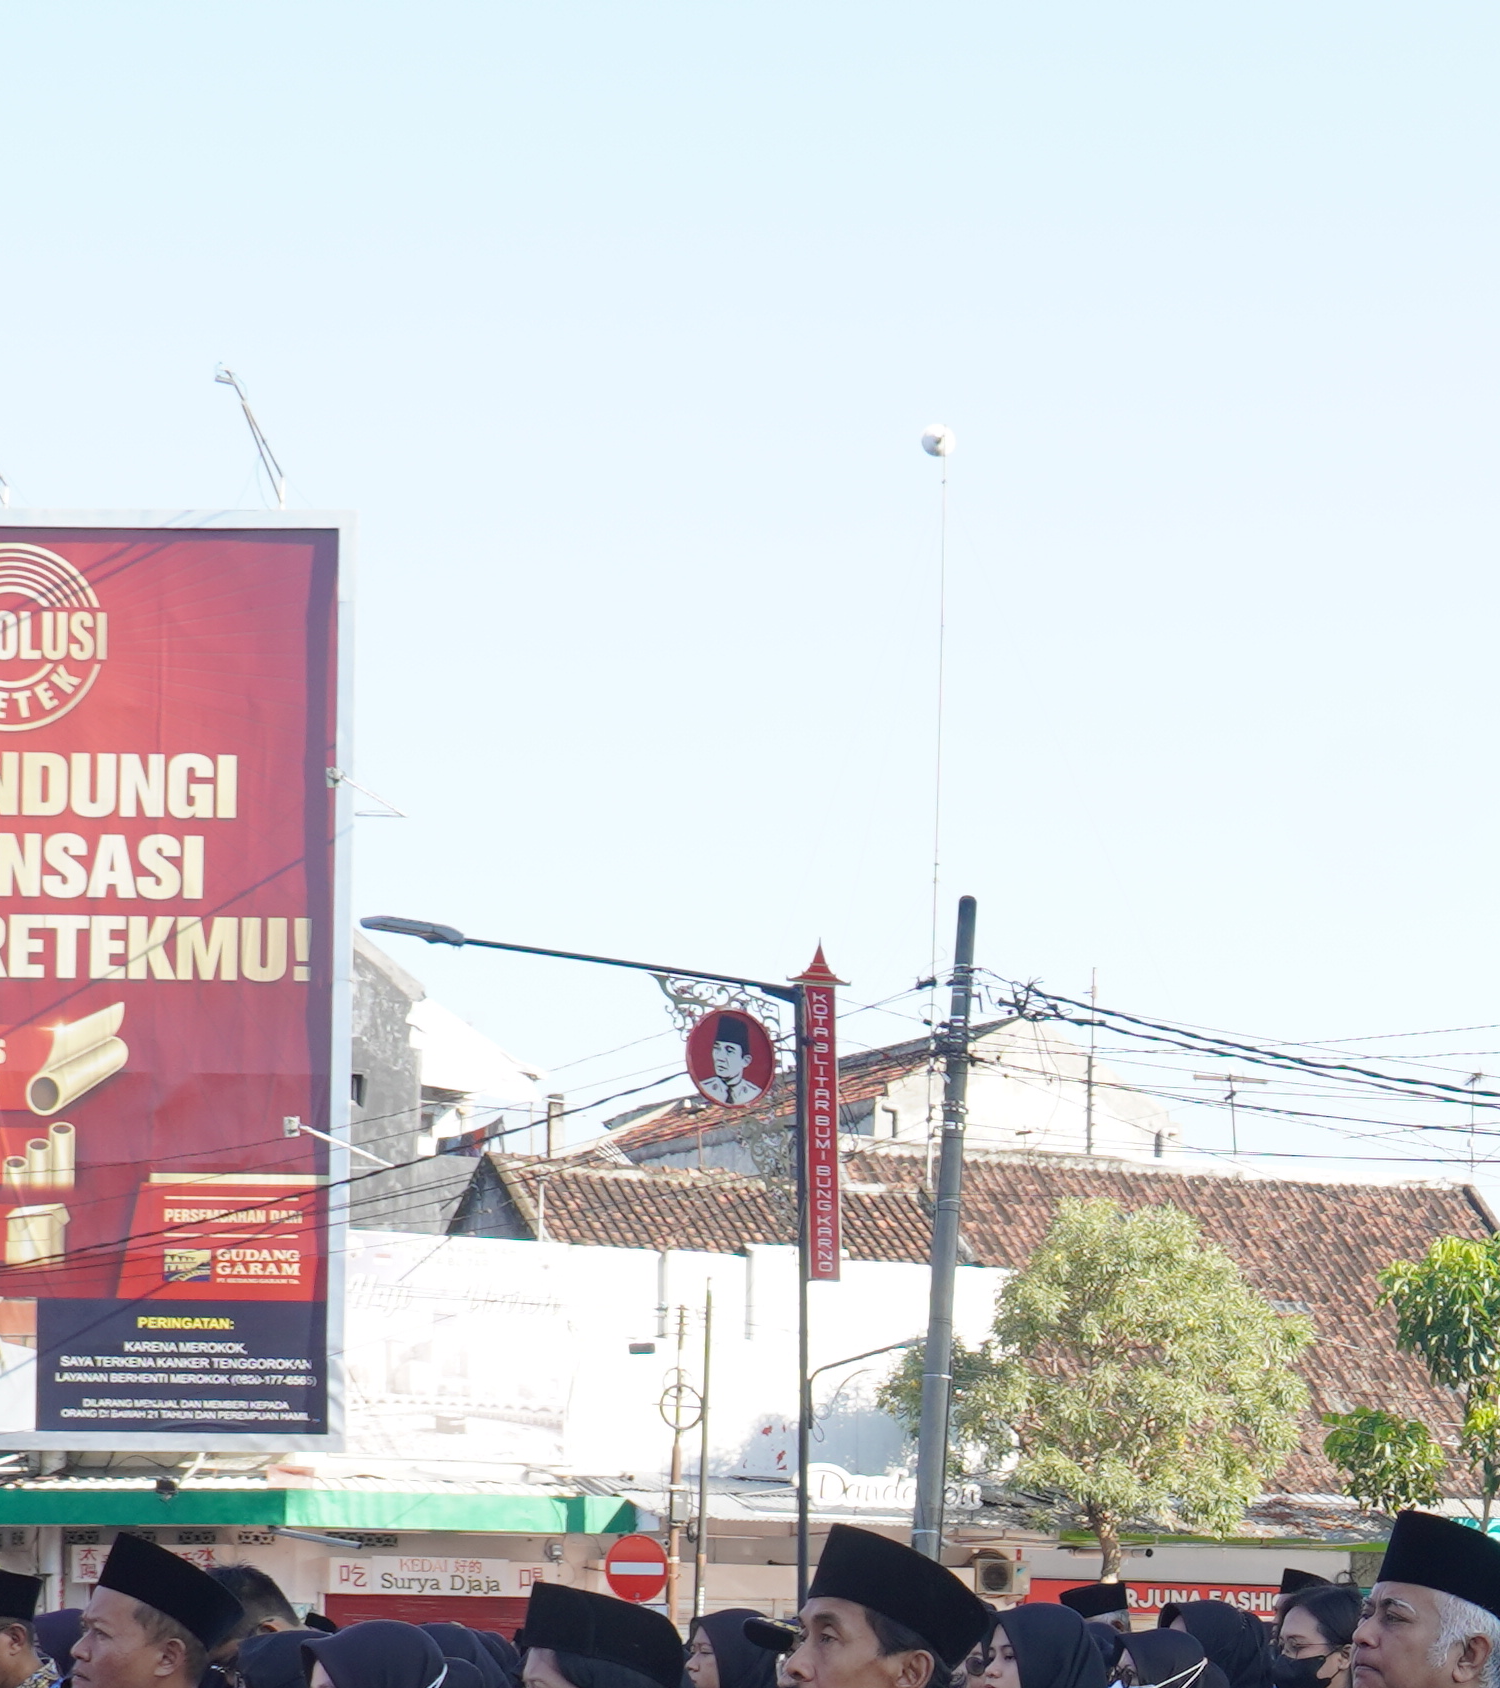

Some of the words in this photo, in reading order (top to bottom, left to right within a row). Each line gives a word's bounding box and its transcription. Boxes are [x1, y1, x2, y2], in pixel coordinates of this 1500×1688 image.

[812, 991, 829, 1038] KOTA
[813, 1042, 831, 1112] BLITAR
[814, 1115, 831, 1161] BUMI
[815, 1165, 833, 1212] BUNG
[816, 1215, 834, 1273] KARNO
[216, 1248, 301, 1262] GUDANG
[216, 1261, 301, 1276] GARAM
[137, 1316, 235, 1331] PERINGATAN:
[123, 1341, 179, 1353] KARENA
[60, 1355, 94, 1368] SAYA
[94, 1356, 156, 1368] TERKENA
[156, 1357, 210, 1369] KANKER
[212, 1358, 312, 1371] TENGGOROKAN
[55, 1372, 108, 1383] LAYANAN
[109, 1373, 169, 1384] BERHENTI
[170, 1373, 230, 1385] MEROKOK
[82, 1398, 133, 1409] DILARANG
[180, 1400, 202, 1409] DAN
[249, 1401, 290, 1410] KEPADA
[60, 1408, 97, 1419] ORANG
[147, 1410, 159, 1419] 21
[159, 1410, 193, 1419] TAHUN
[195, 1410, 216, 1420] DAN
[400, 1558, 448, 1573] KEDAI
[339, 1563, 368, 1588] 吃
[380, 1572, 441, 1593] Surya
[450, 1574, 501, 1595] Djaja
[1125, 1588, 1201, 1609] RJUNA
